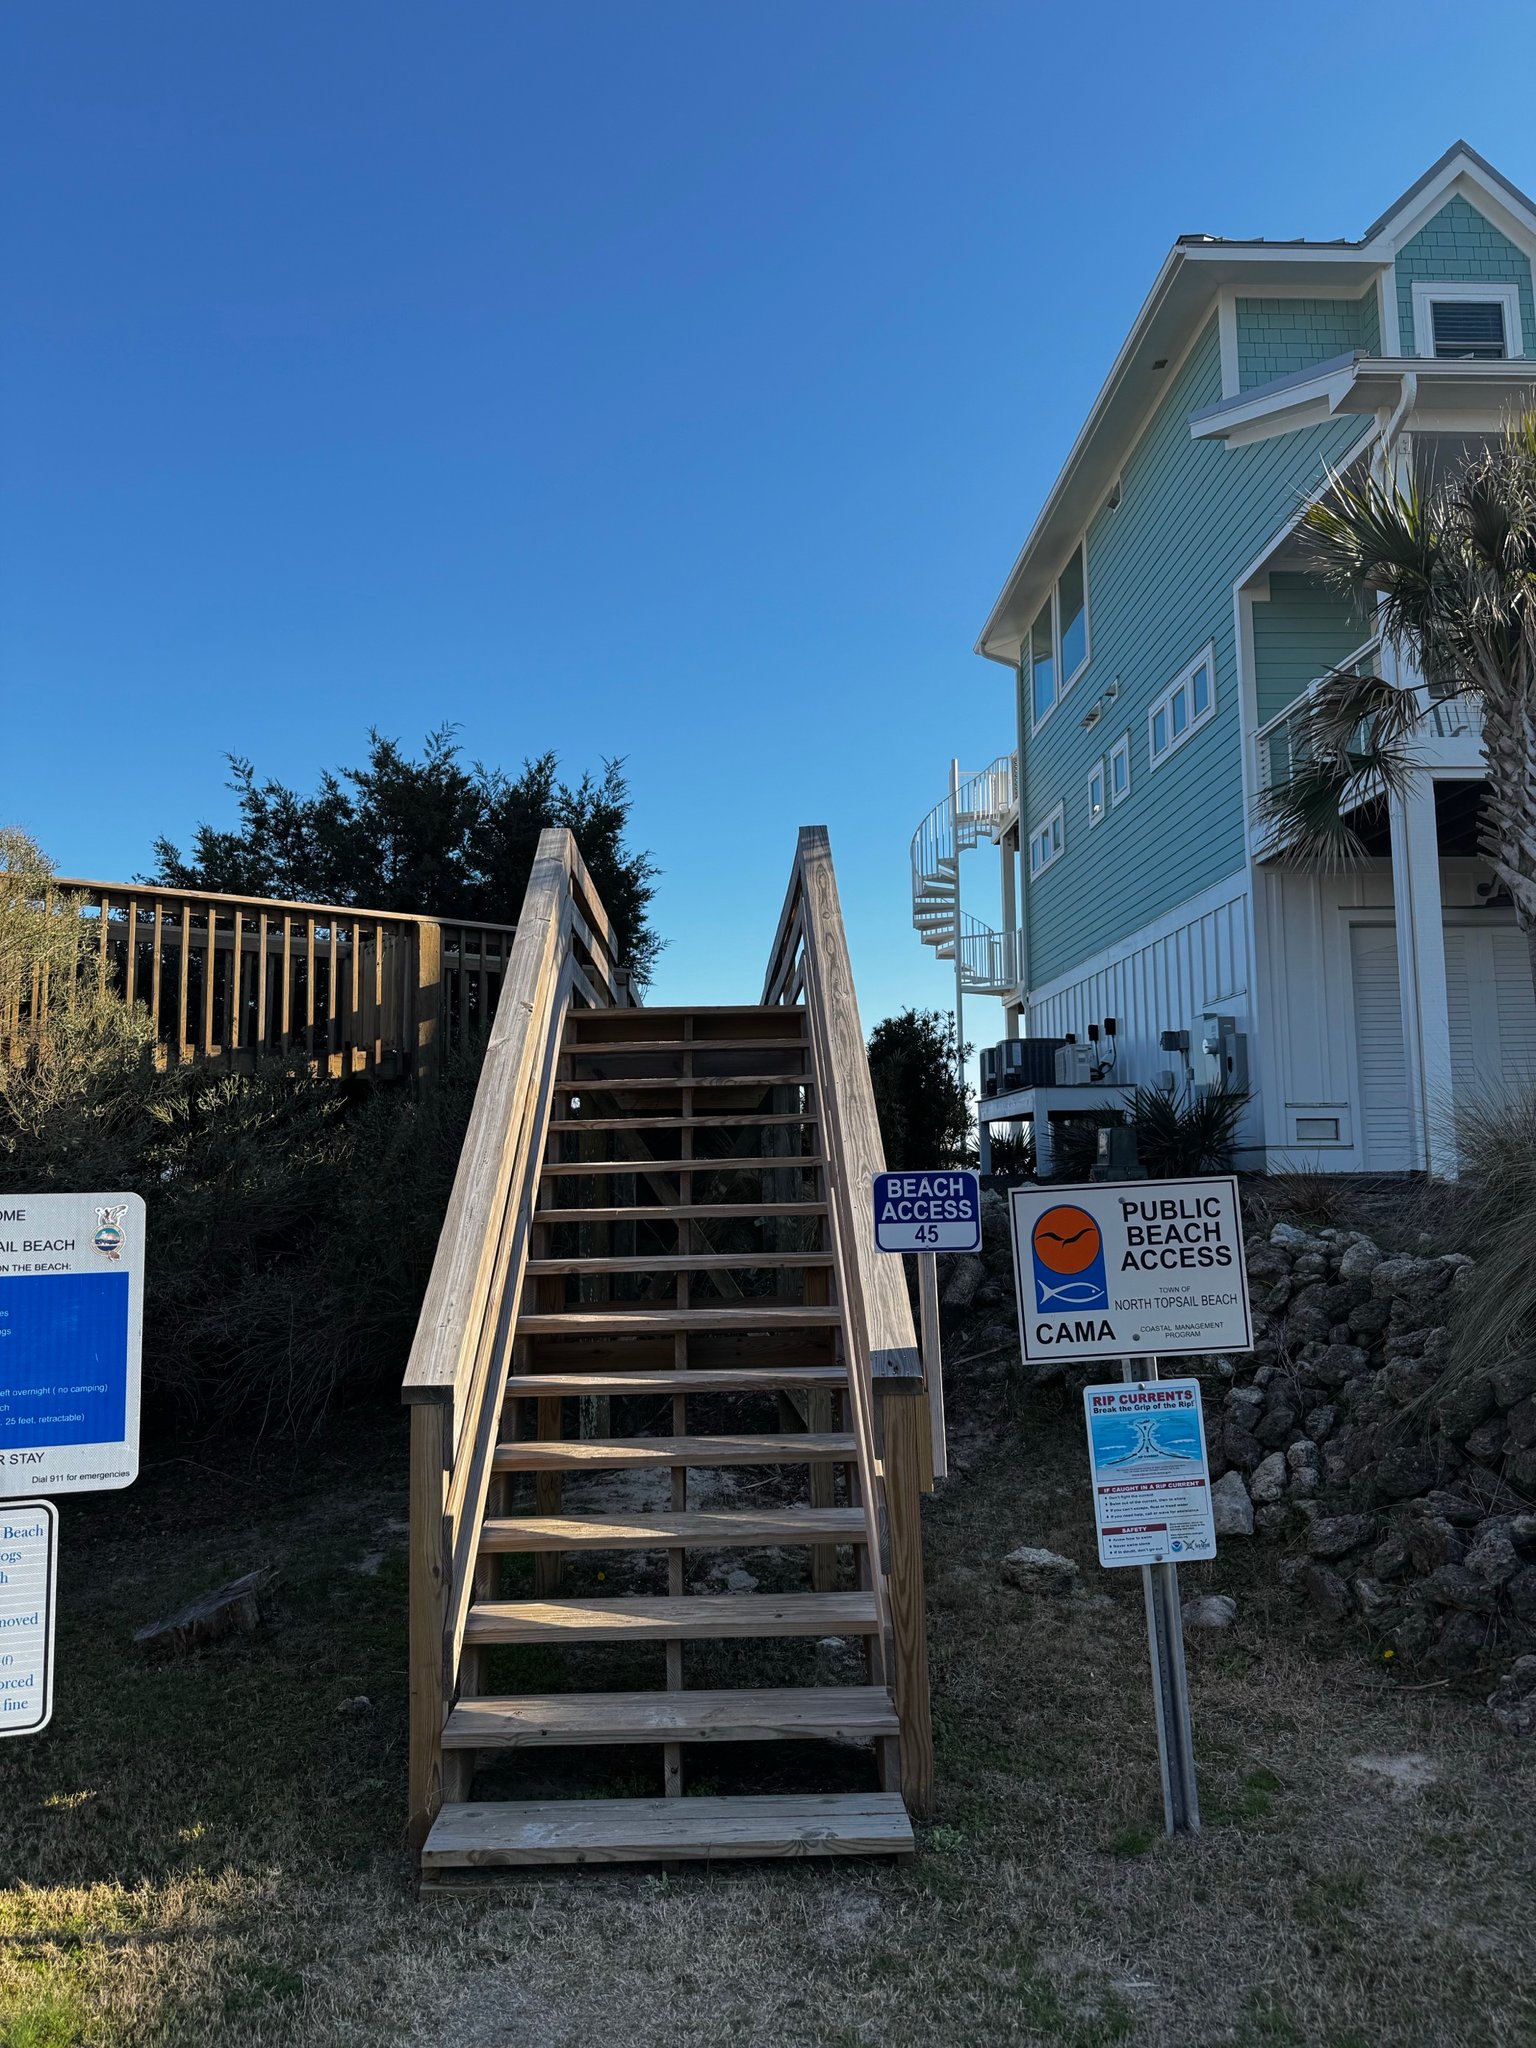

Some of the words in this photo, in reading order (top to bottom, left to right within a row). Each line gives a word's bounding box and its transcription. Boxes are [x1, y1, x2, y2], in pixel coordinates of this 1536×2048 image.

[887, 1177, 964, 1198] BEACH
[881, 1200, 973, 1220] ACCESS
[1122, 1197, 1221, 1223] PUBLIC
[915, 1225, 939, 1243] 45
[1127, 1222, 1221, 1247] BEACH
[23, 1239, 75, 1252] BEACH
[1121, 1245, 1232, 1271] ACCESS
[12, 1264, 32, 1272] THE
[35, 1263, 72, 1271] BEACH:
[1158, 1286, 1179, 1294] TOWN
[1115, 1298, 1152, 1311] NORTH
[1155, 1296, 1199, 1308] TOPSAIL
[1201, 1294, 1238, 1306] BEACH
[1036, 1320, 1116, 1345] CAMA
[1140, 1324, 1172, 1332] COASTAL
[1174, 1322, 1224, 1330] MANAGEMENT
[1165, 1330, 1201, 1339] PROGRAM
[12, 1387, 50, 1396] overnight
[71, 1384, 108, 1394] camping)
[1093, 1395, 1115, 1406] RIP
[1119, 1390, 1193, 1404] CURRENTS
[1134, 1404, 1151, 1412] Grip
[1179, 1400, 1195, 1408] Rip!
[5, 1418, 16, 1426] 25
[38, 1413, 85, 1423] retractable)
[10, 1452, 45, 1465] STAY
[32, 1475, 48, 1484] Dial
[50, 1474, 64, 1482] 911
[79, 1470, 130, 1480] emergencies
[4, 1524, 44, 1539] Beach
[4, 1698, 28, 1711] fine
